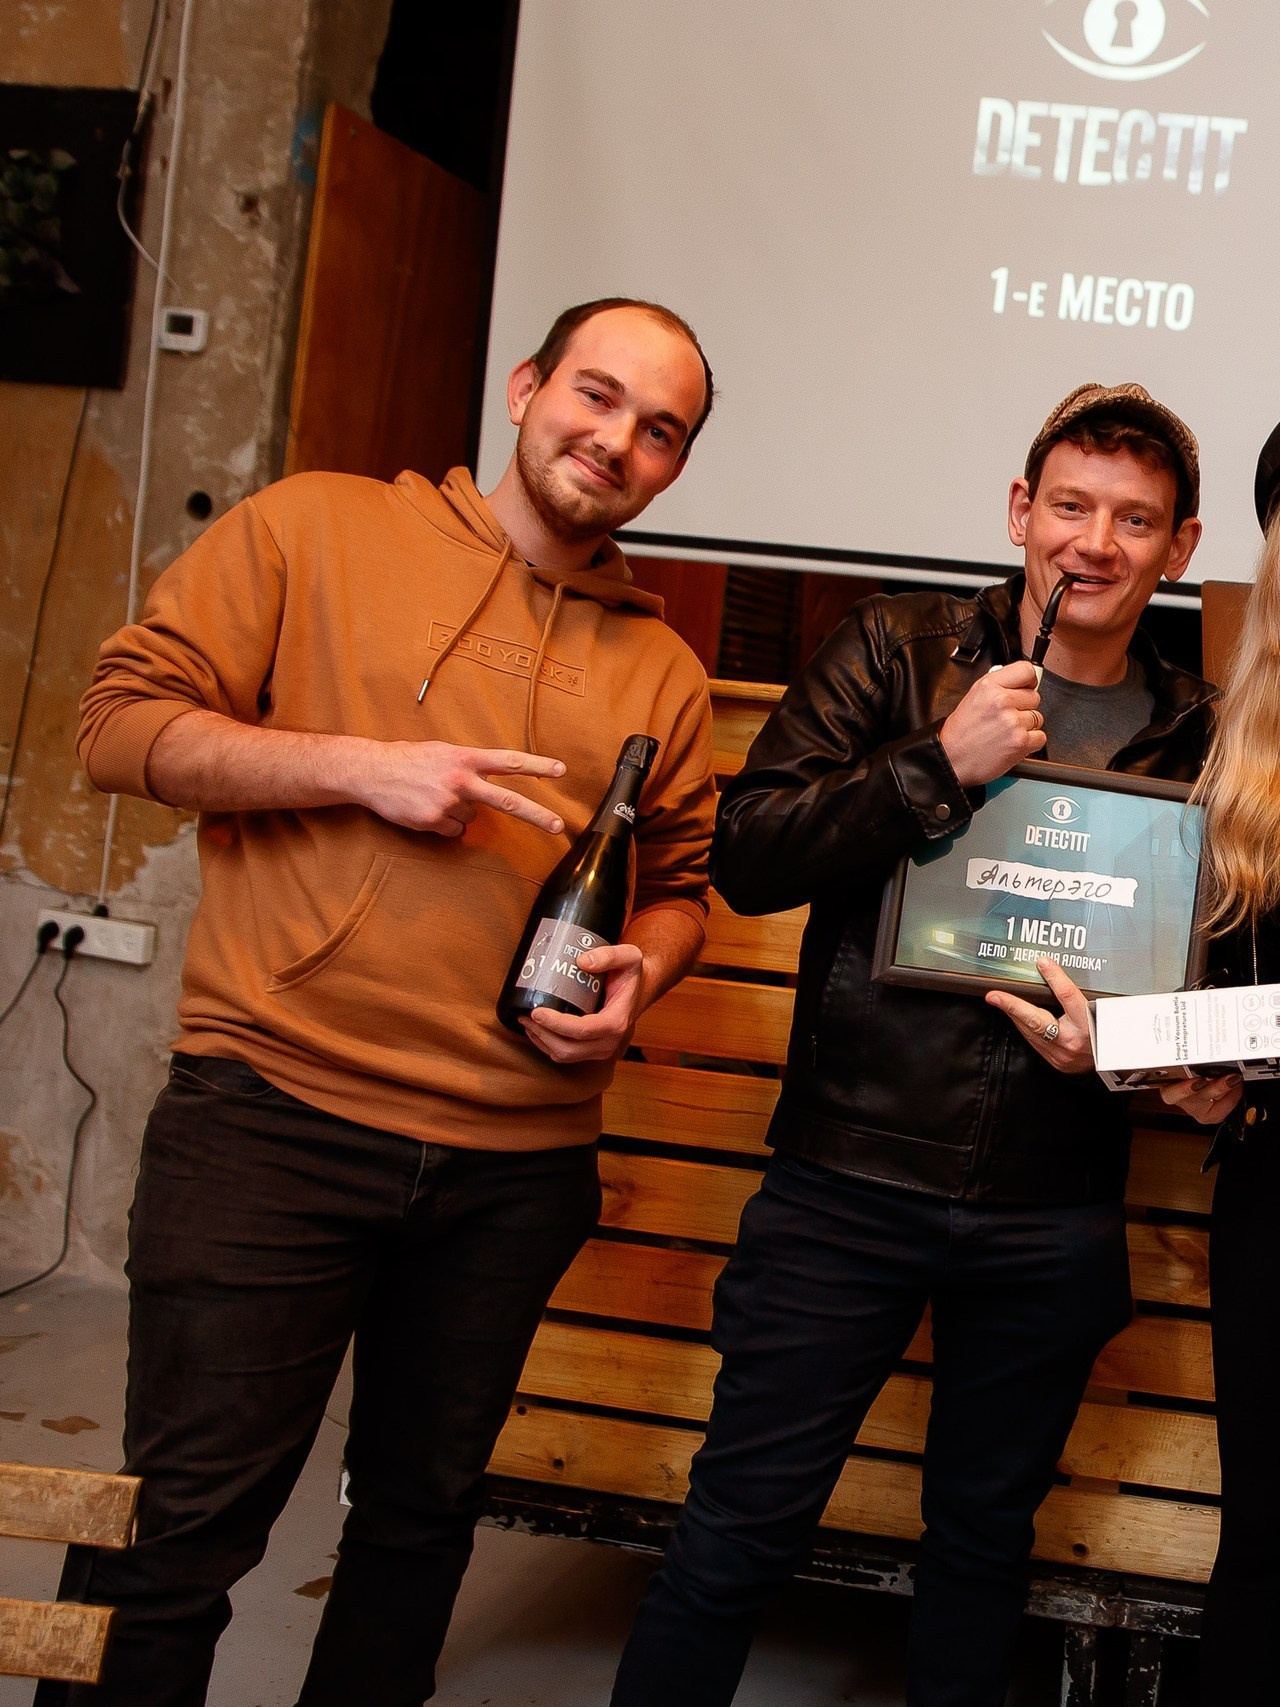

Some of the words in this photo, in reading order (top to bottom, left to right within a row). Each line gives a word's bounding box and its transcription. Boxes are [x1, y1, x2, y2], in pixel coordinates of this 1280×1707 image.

[972, 97, 1248, 195] DETECTIT
[1058, 272, 1195, 331] МЕСТО
[1025, 825, 1091, 853] DETECTIT
[978, 942, 1007, 958] ДЕЛО
[1007, 916, 1016, 941] 1
[1020, 918, 1087, 950] МЕСТО
[539, 954, 546, 968] 1
[550, 958, 600, 993] МЕСТО
